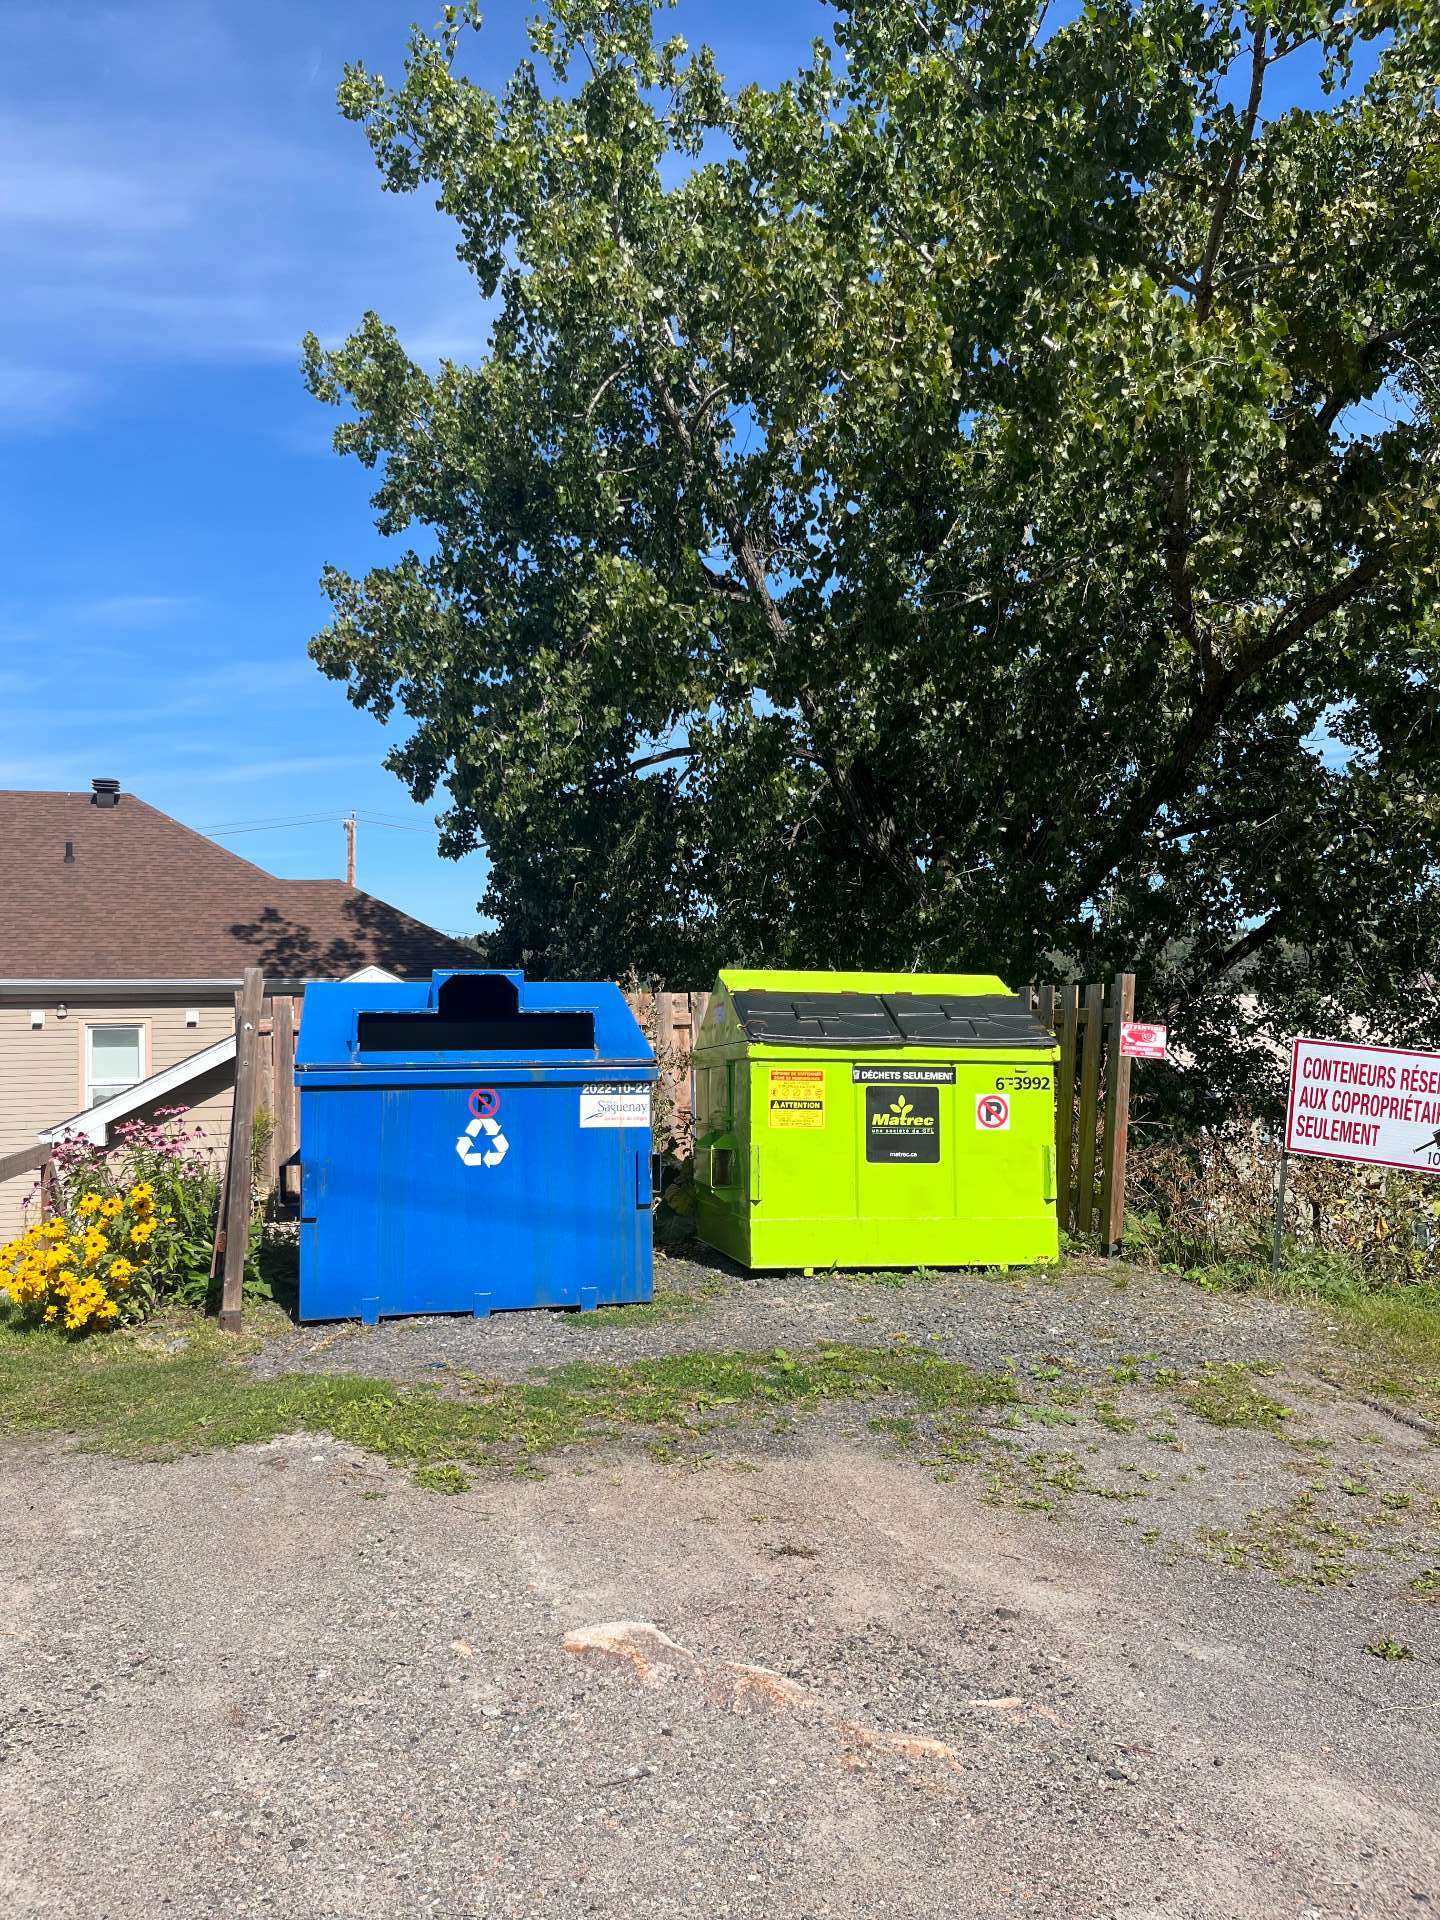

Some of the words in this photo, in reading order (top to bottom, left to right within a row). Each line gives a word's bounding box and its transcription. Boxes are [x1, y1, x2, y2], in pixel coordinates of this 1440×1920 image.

[861, 1070, 901, 1080] DÉCHETS
[902, 1071, 954, 1081] SEULEMENT
[1303, 1057, 1396, 1089] CONTENEURS
[582, 1083, 650, 1095] 2022-10-22
[780, 1101, 821, 1109] ATTENTION
[1299, 1086, 1329, 1110] AUX
[597, 1099, 648, 1115] Saguenay
[871, 1112, 935, 1126] Matrec
[1296, 1115, 1381, 1147] SEULEMENT
